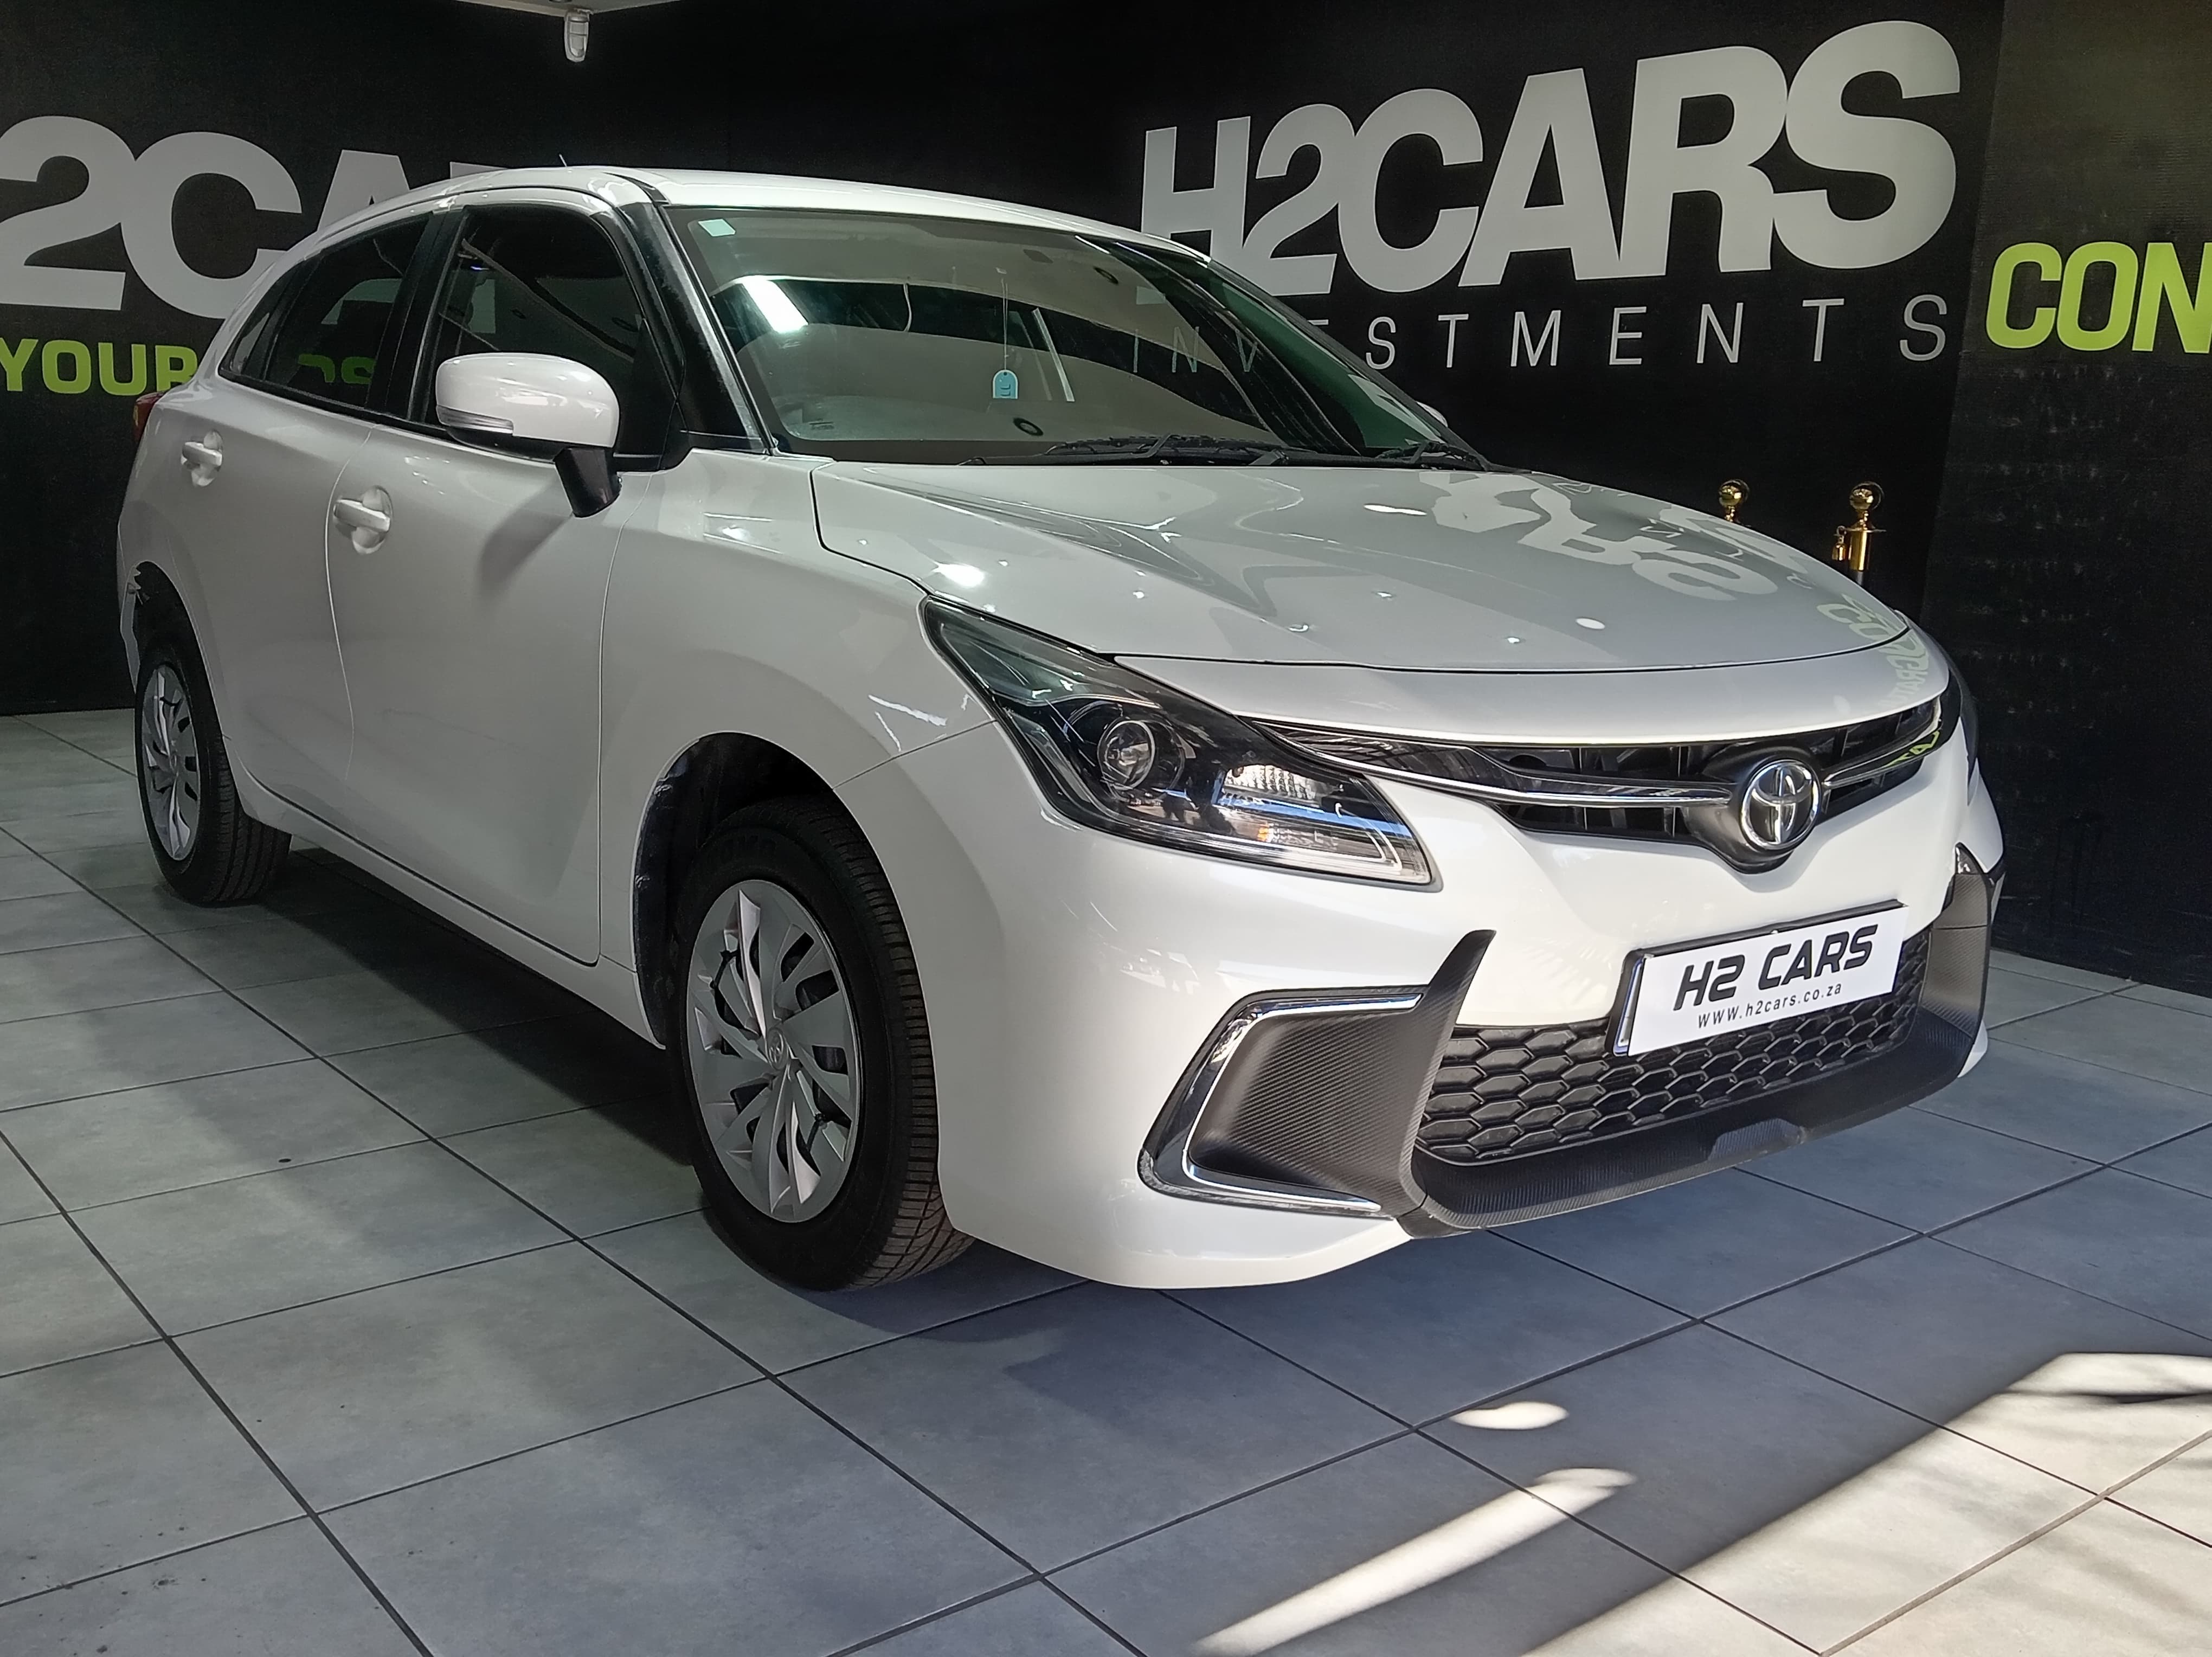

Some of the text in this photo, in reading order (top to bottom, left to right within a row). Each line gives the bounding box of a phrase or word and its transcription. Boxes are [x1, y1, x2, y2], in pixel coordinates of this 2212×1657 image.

[1141, 21, 1960, 296] H2CARS
[1133, 294, 1947, 374] INVSTMENTS
[1986, 242, 2212, 354] CON
[1674, 924, 1878, 1011] H2 CARS
[1699, 982, 1842, 1029] www.h2cars.co.za
